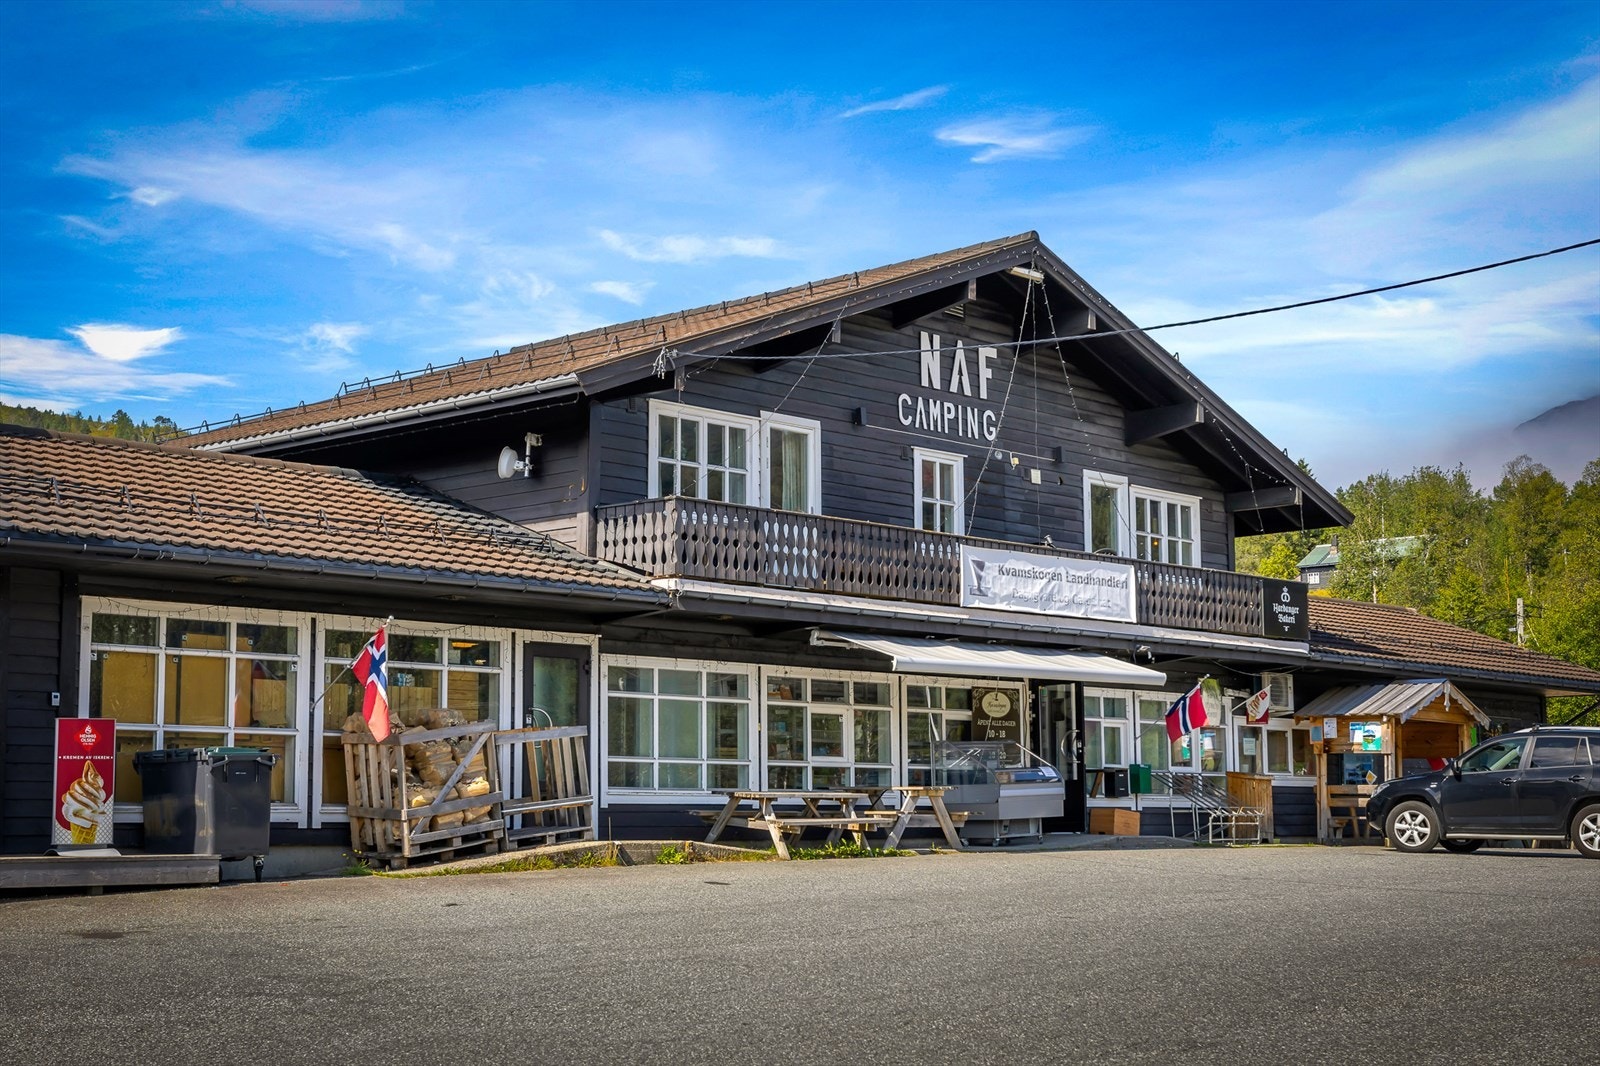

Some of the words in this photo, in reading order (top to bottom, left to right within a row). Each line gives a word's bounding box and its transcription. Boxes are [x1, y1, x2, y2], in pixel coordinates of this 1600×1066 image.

[920, 331, 998, 400] NAF
[898, 393, 997, 441] CAMPING
[998, 563, 1063, 583] Kvamskogen
[1066, 570, 1128, 590] Landhandleri
